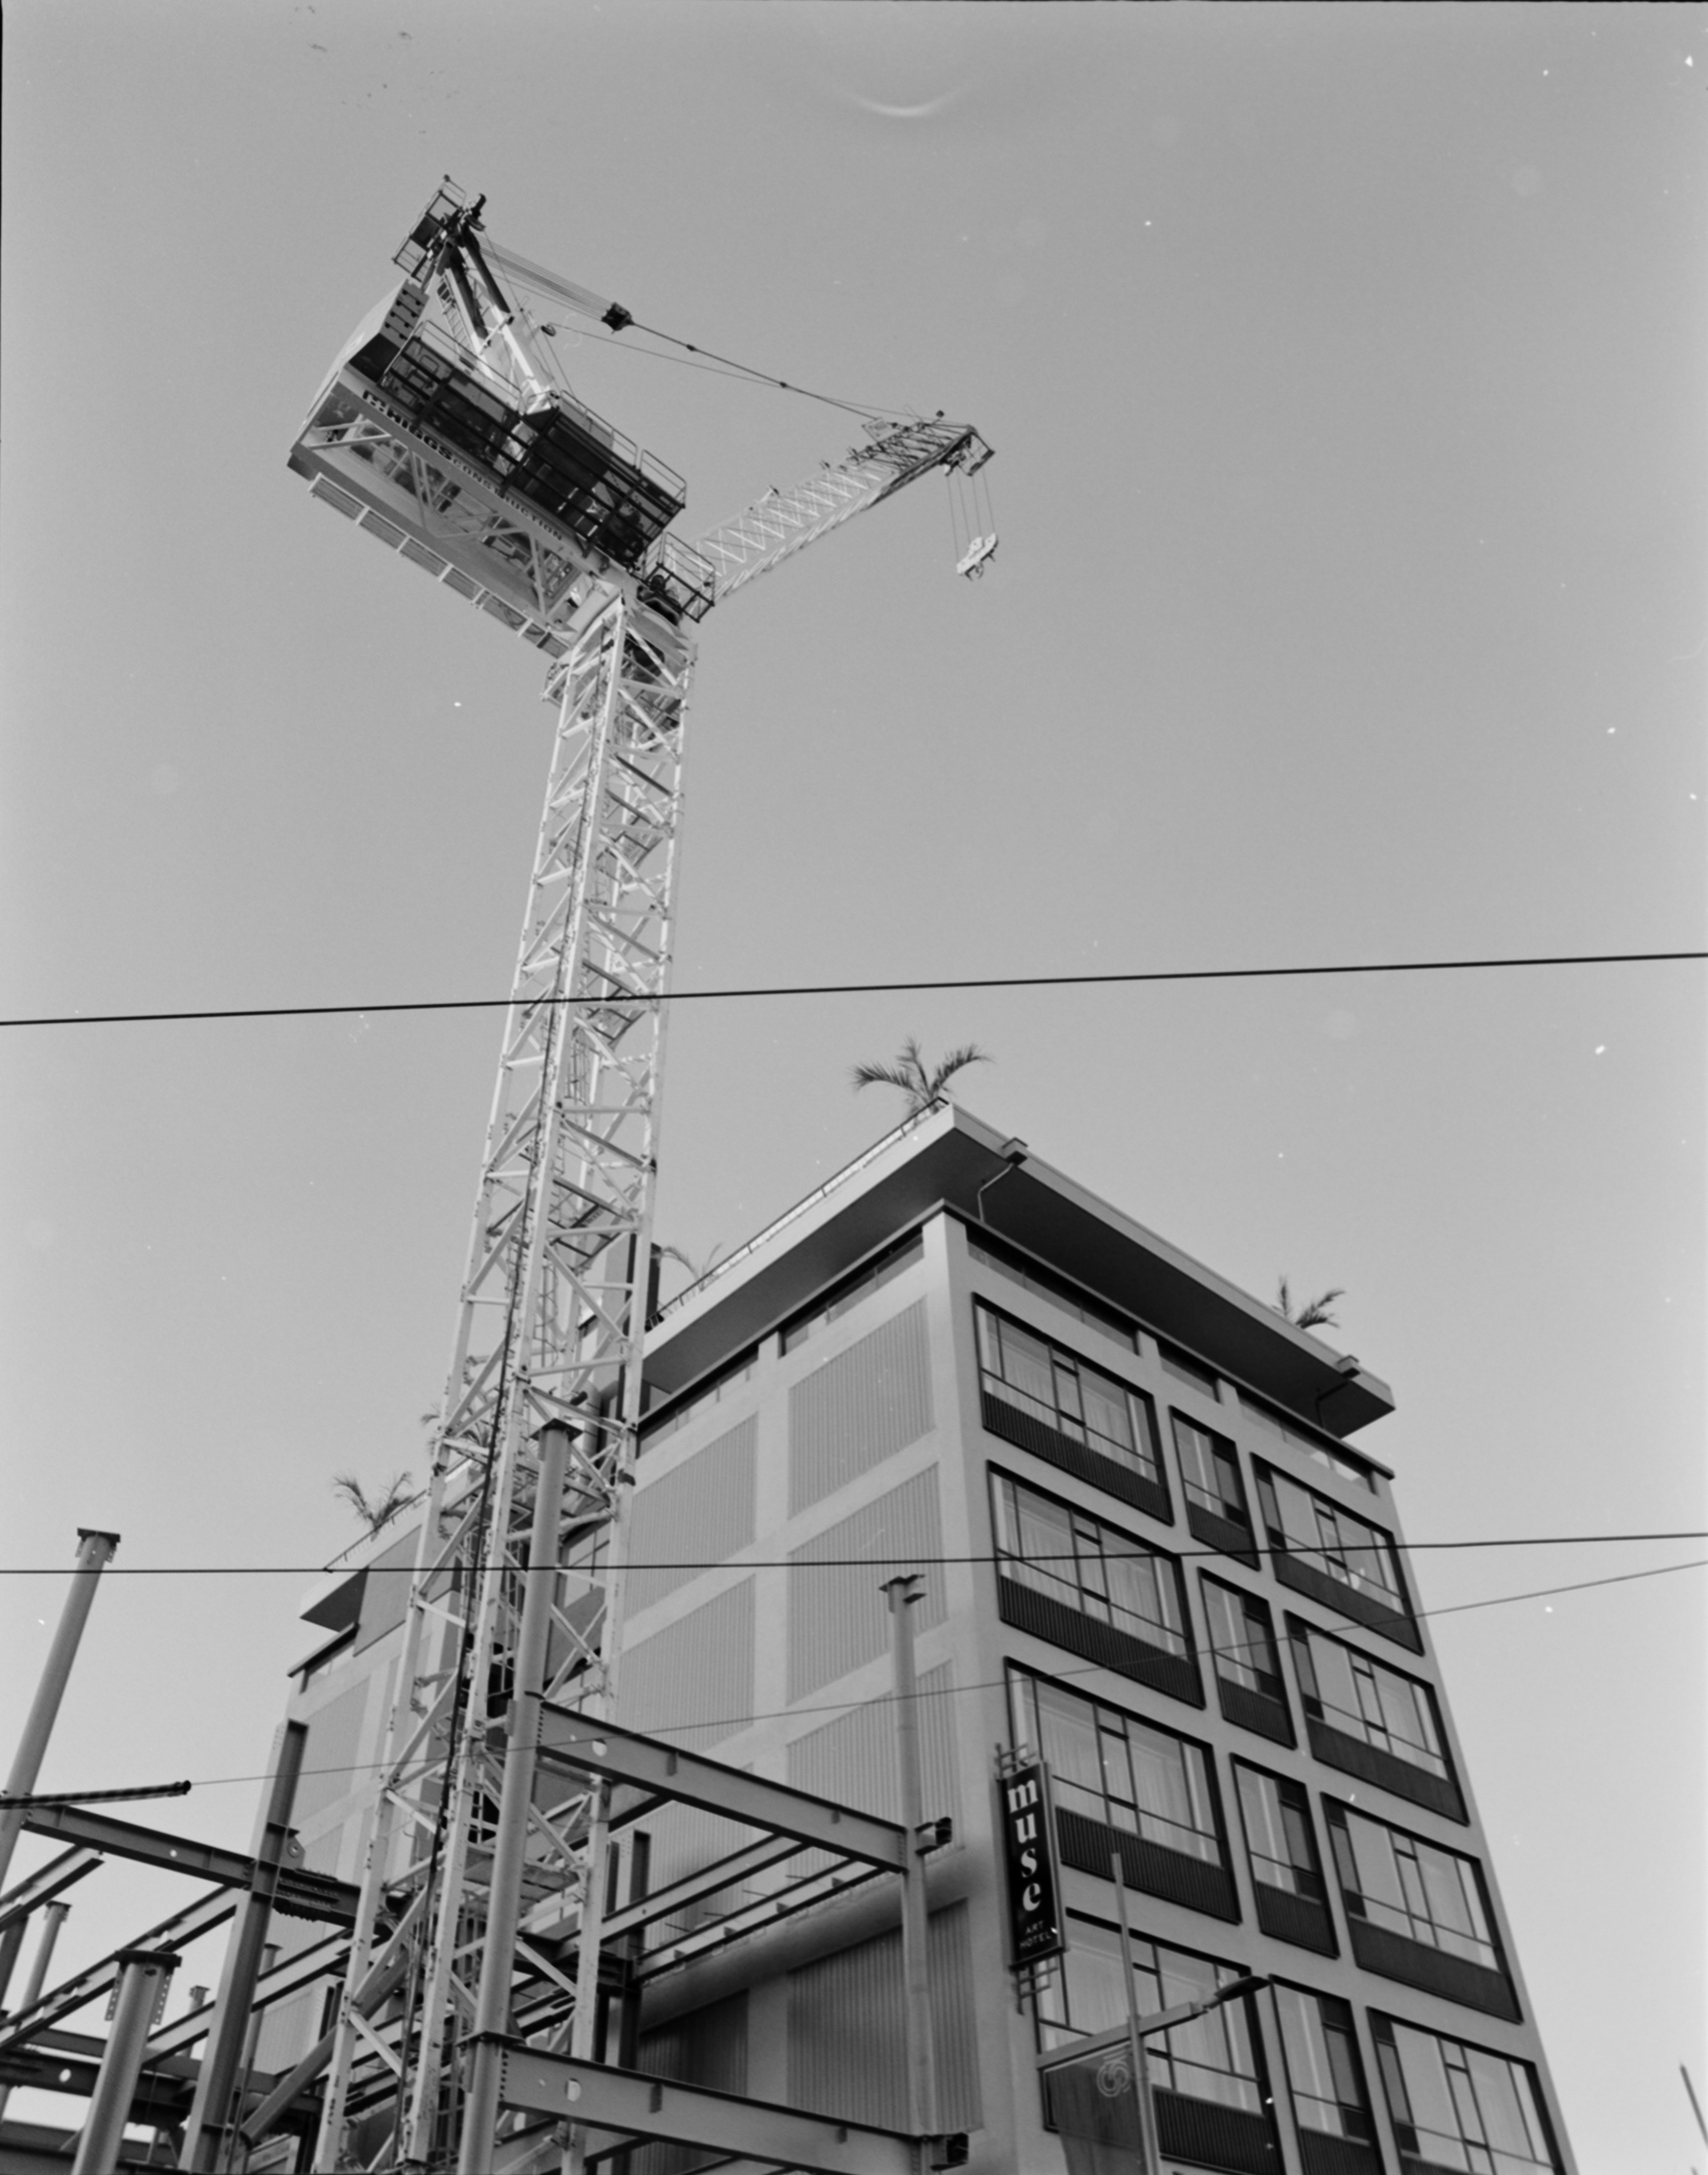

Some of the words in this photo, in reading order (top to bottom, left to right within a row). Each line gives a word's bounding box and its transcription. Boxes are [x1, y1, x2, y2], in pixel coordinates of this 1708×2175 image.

[386, 408, 453, 461] HIGGS
[1007, 1779, 1041, 1912] muse
[1019, 1931, 1051, 1949] HOTEL
[1026, 1920, 1043, 1934] ART
